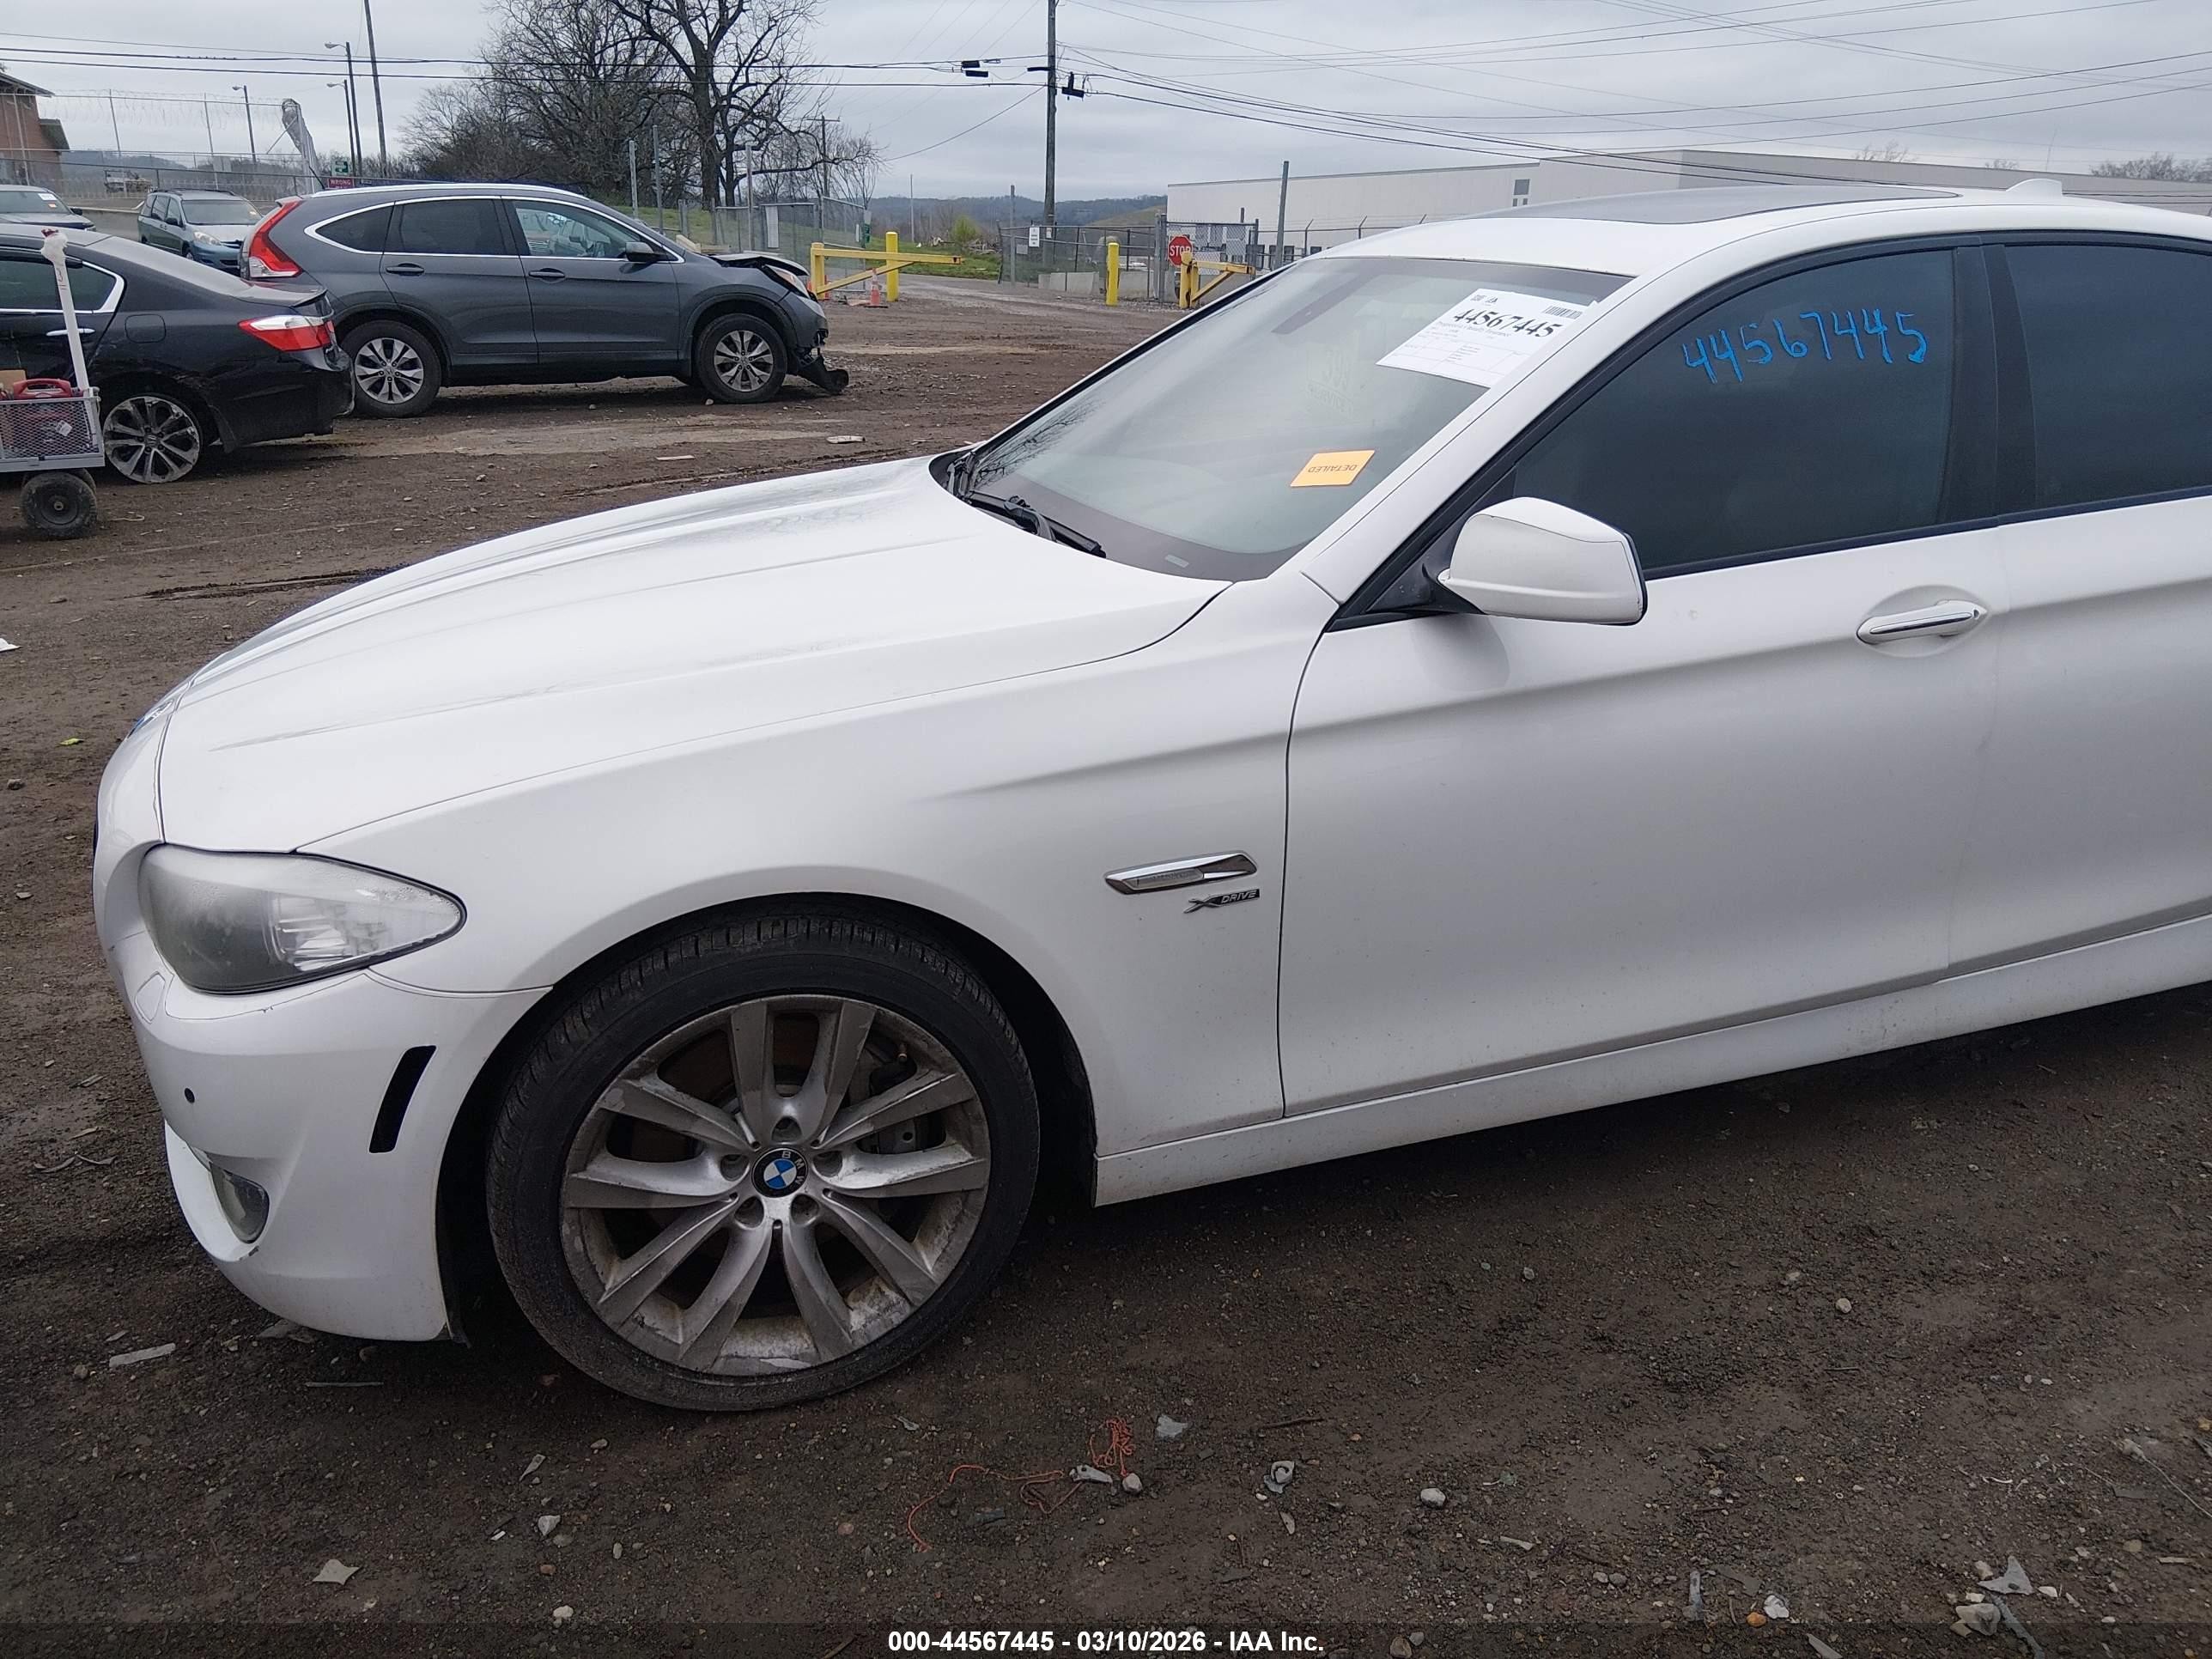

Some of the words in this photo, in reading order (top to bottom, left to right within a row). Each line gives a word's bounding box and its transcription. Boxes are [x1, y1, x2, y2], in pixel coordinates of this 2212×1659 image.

[1454, 308, 1563, 337] 44567445
[1682, 308, 1928, 384] 44567445
[1308, 465, 1358, 473] DETAILED
